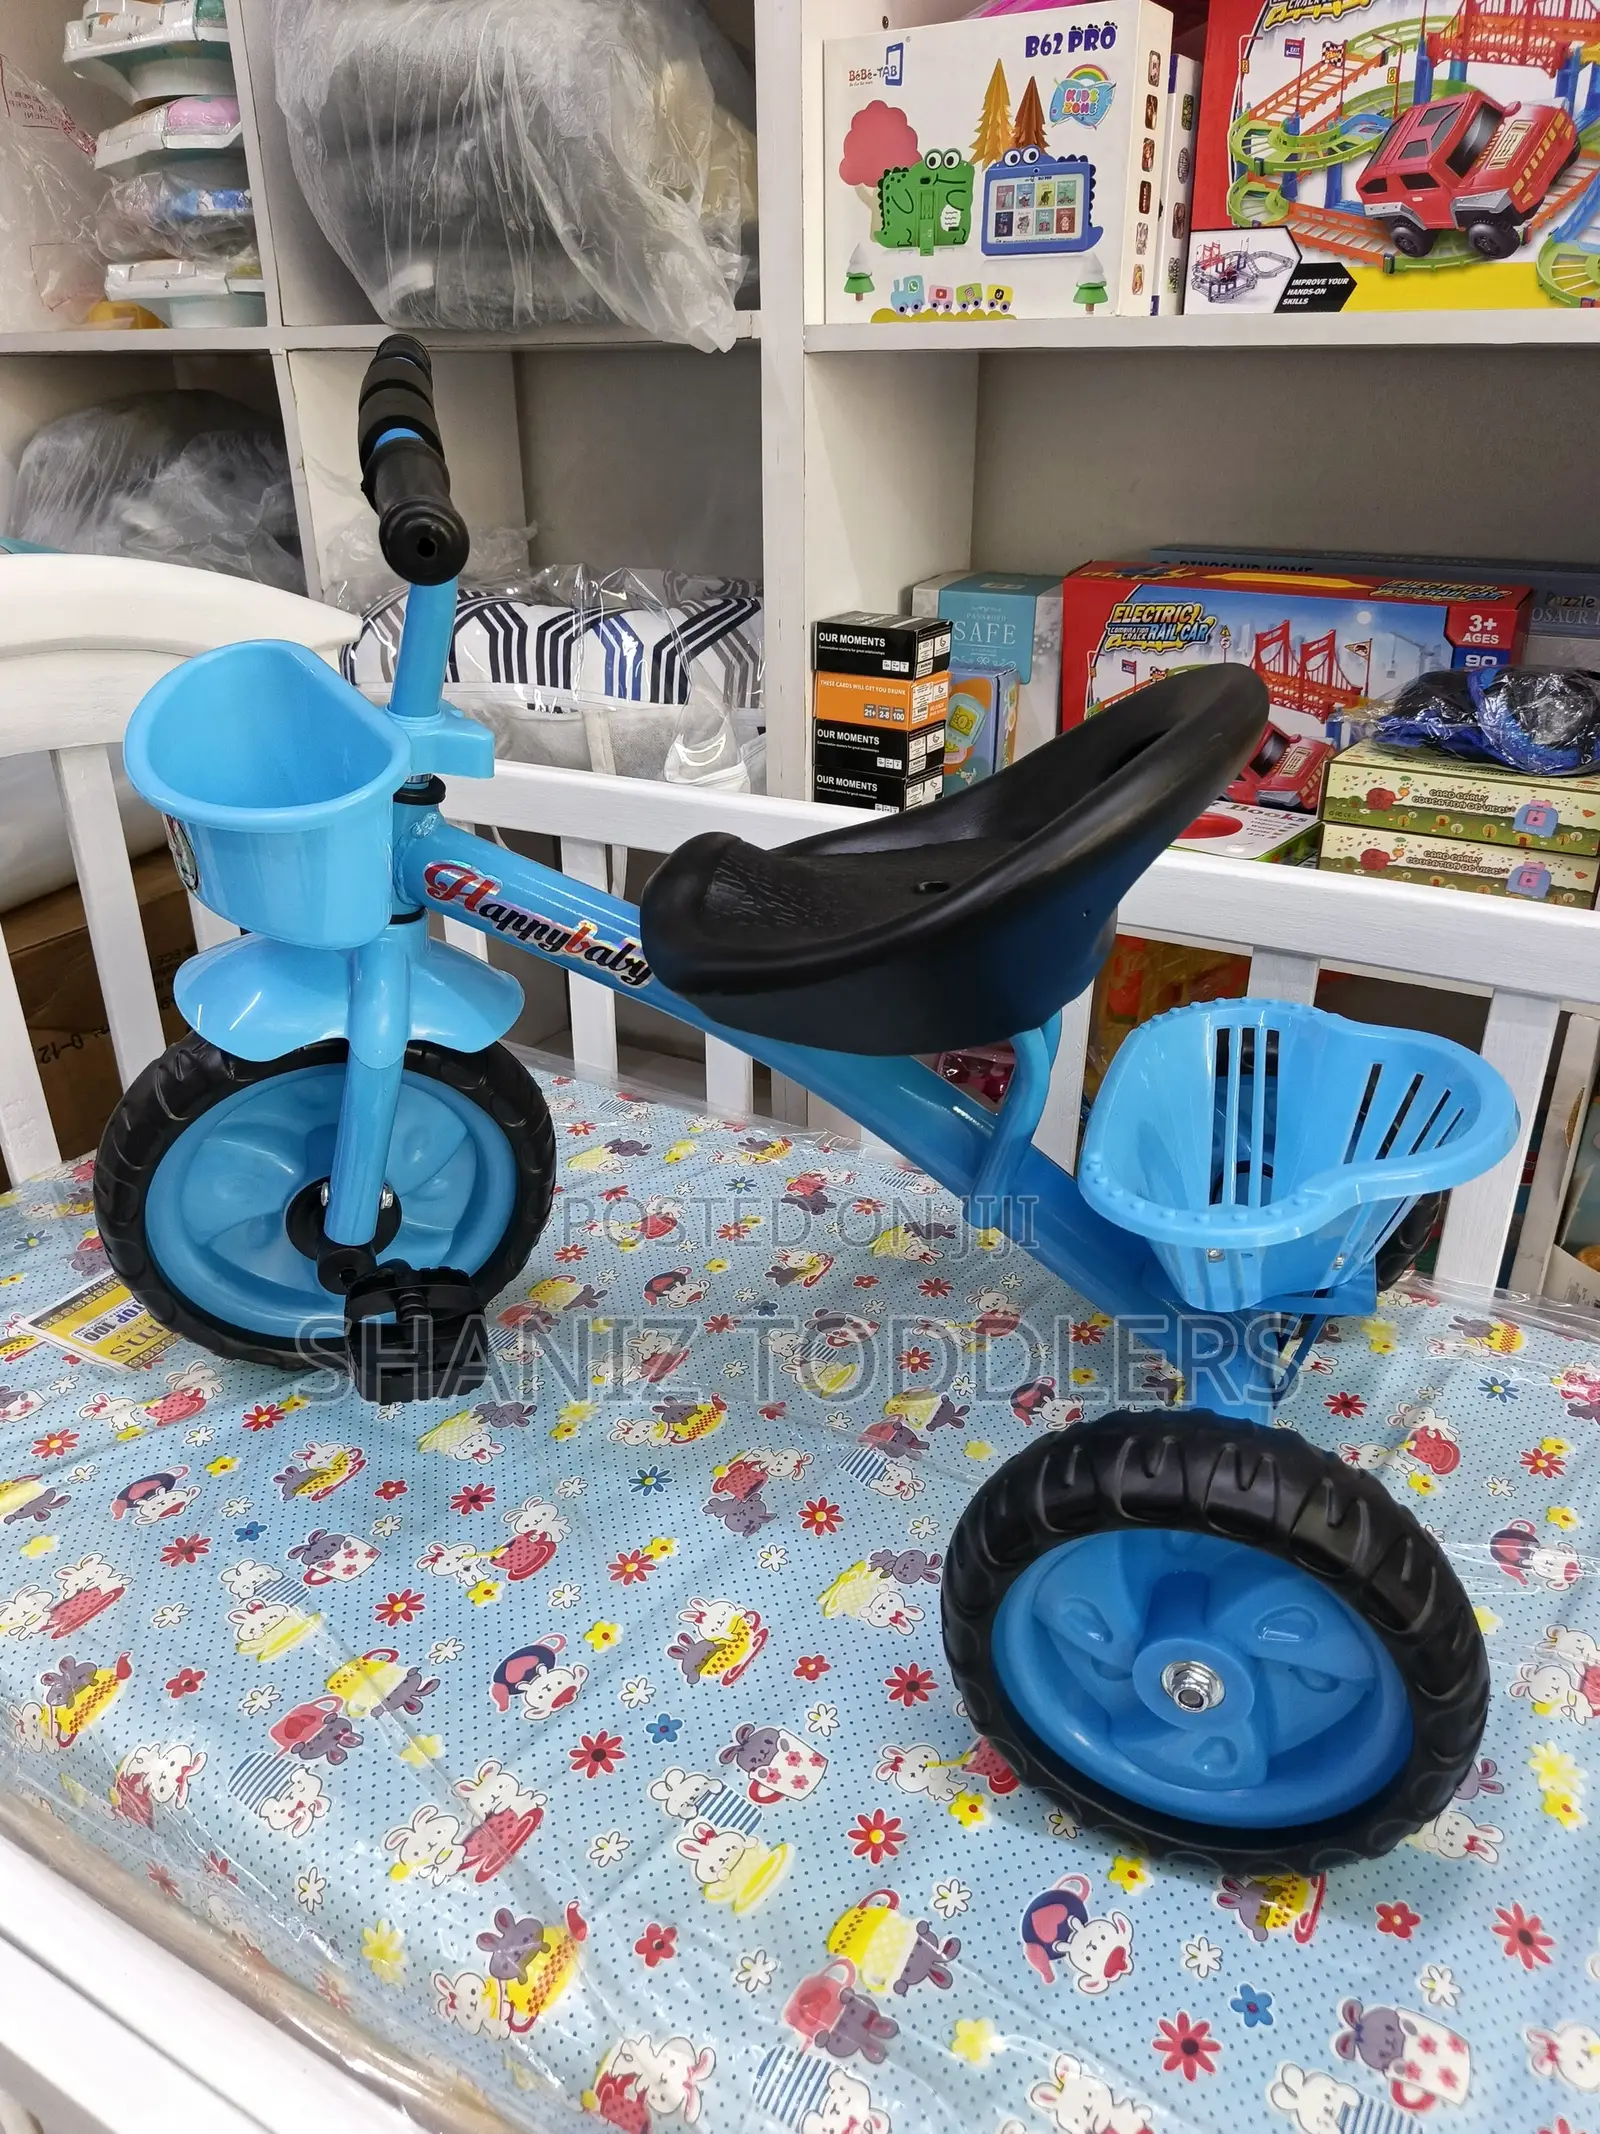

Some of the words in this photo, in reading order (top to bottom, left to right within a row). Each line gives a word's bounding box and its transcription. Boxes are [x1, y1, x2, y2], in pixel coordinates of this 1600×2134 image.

[1025, 32, 1063, 58] B62
[1068, 25, 1116, 53] PRO
[1065, 89, 1099, 103] KIDS
[1062, 102, 1098, 115] ZONE
[1291, 278, 1327, 286] IMPROVE
[1287, 288, 1327, 296] HANDS-ON
[1469, 614, 1497, 632] 3+
[818, 632, 838, 643] OUR
[840, 634, 886, 647] MOMENTS
[953, 620, 1016, 645] SAFE
[1148, 624, 1177, 640] RAIL
[1180, 624, 1209, 641] CAR
[1462, 633, 1500, 645] AGES
[1465, 655, 1497, 666] 90
[835, 681, 852, 689] CARDS
[888, 688, 906, 696] DRUNK
[864, 709, 876, 717] 21+
[879, 710, 890, 719] 2-8
[893, 712, 905, 721] 100
[817, 728, 835, 739] OUR
[836, 731, 880, 745] MOMENTS
[816, 774, 835, 785] OUR
[835, 777, 878, 792] MOMENTS
[1429, 788, 1455, 800] CARD
[1423, 849, 1449, 861] CARD
[423, 862, 654, 986] Happybaby
[116, 1303, 146, 1324] TOP
[83, 1322, 117, 1341] 100
